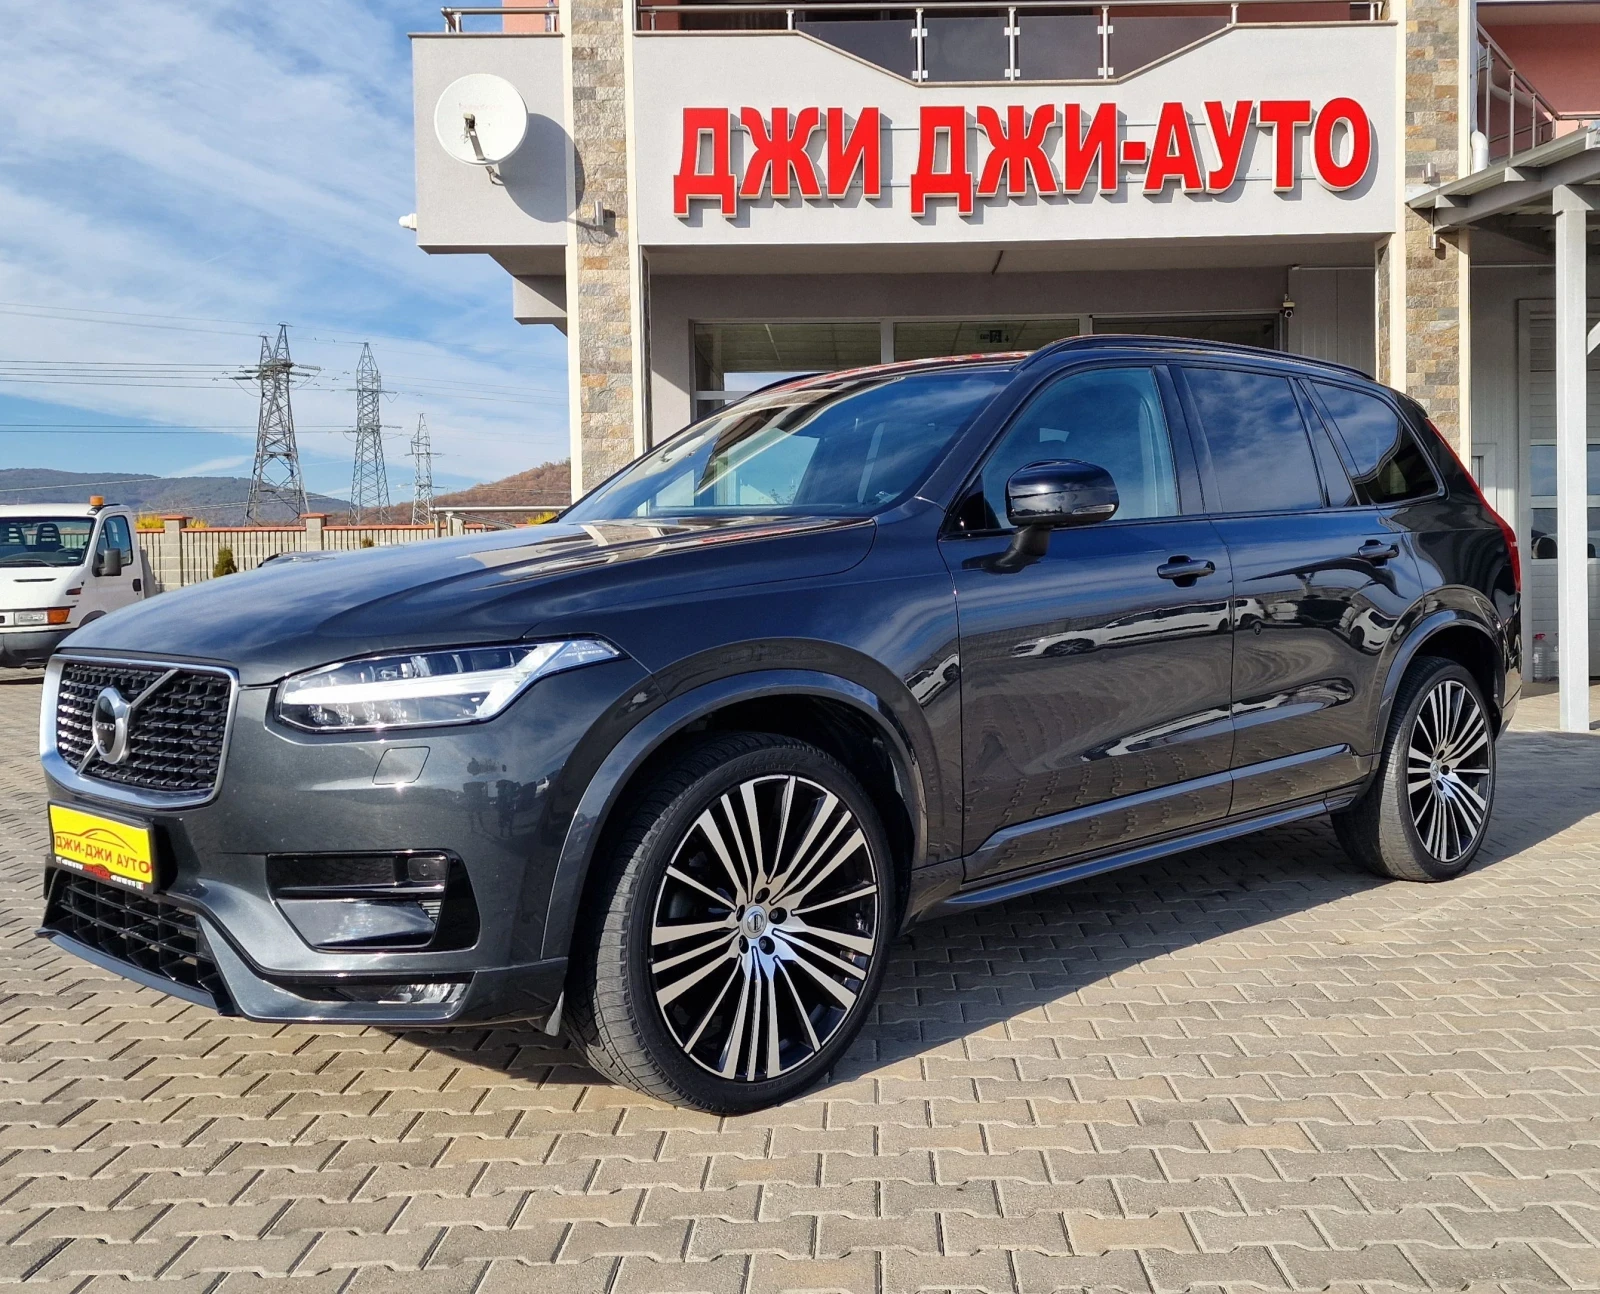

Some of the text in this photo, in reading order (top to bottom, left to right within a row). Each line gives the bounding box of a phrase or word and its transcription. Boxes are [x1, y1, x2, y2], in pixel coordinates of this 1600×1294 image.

[673, 97, 1372, 219] ДЖИ ДЖИ-АУТО
[55, 835, 113, 863] ДЖИ-ДЖИ
[116, 853, 151, 874] АУТО
